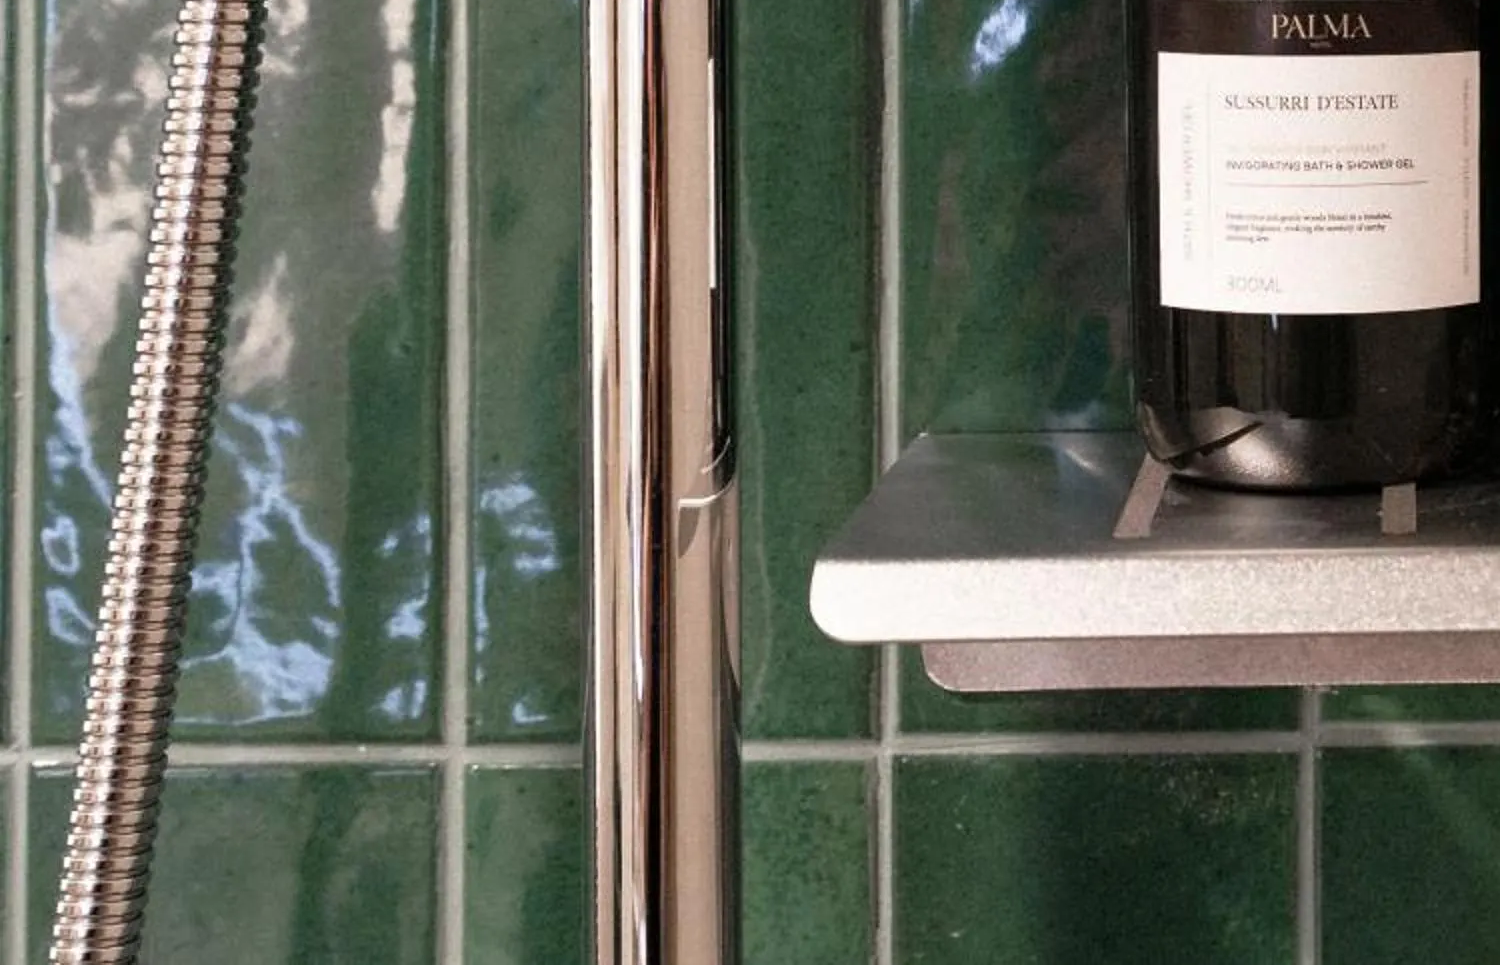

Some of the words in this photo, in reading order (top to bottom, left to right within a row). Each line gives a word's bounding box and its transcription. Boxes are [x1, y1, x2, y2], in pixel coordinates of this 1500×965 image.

[1271, 13, 1372, 39] PALMA
[1224, 94, 1309, 111] SUSSURRI
[1317, 93, 1399, 111] D'ESTATE
[1303, 160, 1334, 172] BATH
[1335, 161, 1343, 172] &
[1346, 159, 1394, 171] SHOWER
[1395, 158, 1416, 169] GEL
